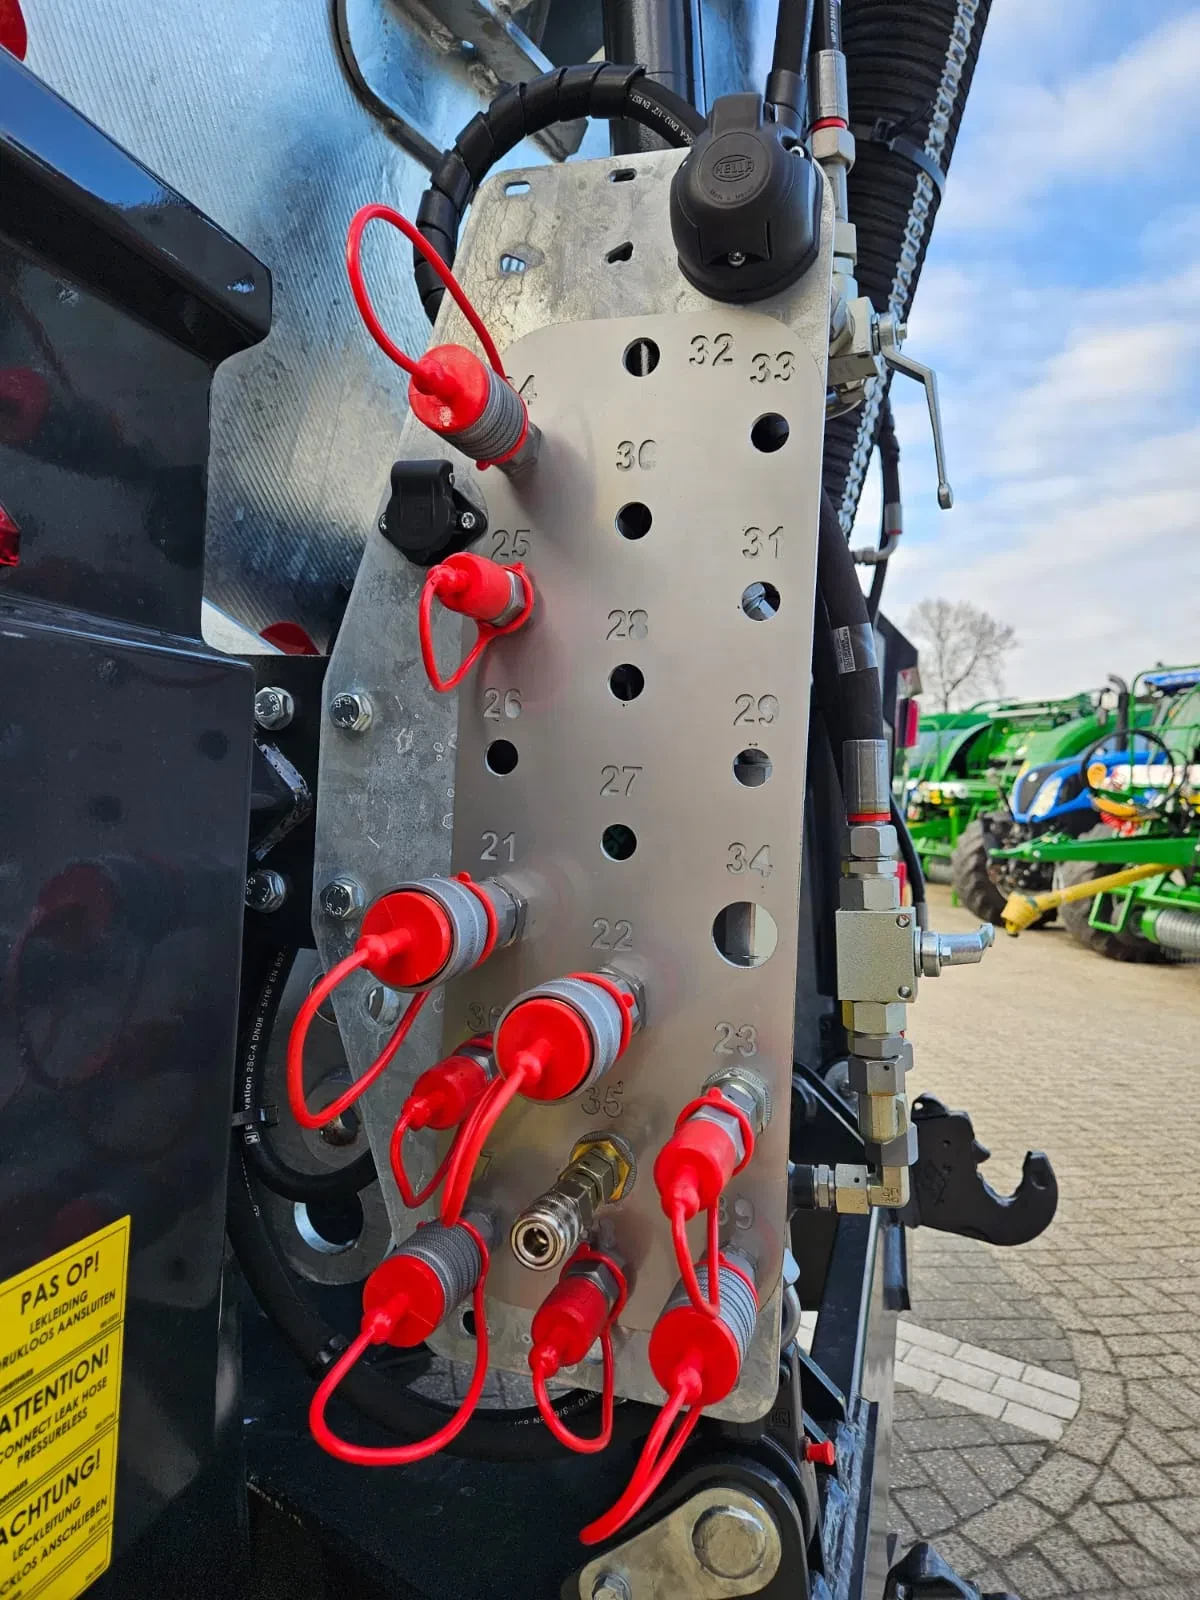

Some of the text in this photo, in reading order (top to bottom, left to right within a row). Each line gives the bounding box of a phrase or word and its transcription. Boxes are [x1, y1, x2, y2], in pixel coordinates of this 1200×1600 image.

[716, 159, 755, 175] HELLA
[688, 333, 735, 367] 32
[749, 351, 796, 384] 33
[492, 529, 532, 560] 25
[741, 526, 785, 559] 31
[606, 609, 649, 641] 28
[483, 687, 522, 719] 26
[732, 693, 780, 727] 29
[599, 765, 643, 798] 27
[480, 830, 516, 863] 21
[726, 841, 776, 878] 34
[590, 917, 634, 951] 22
[713, 1022, 760, 1058] 23
[580, 1084, 625, 1119] 35
[20, 1250, 100, 1315] PAS OP!
[0, 1288, 116, 1369] RUKLOOS AANSLUITEN
[29, 1290, 88, 1335] LEKLEIDING
[0, 1343, 109, 1435] ATTENTION!
[54, 1396, 80, 1423] LEAK
[81, 1376, 107, 1404] HOSE
[17, 1407, 88, 1469] PRESSURELESS
[0, 1447, 101, 1546] ACHTUNG!
[12, 1496, 81, 1562] LECKLEITUNG
